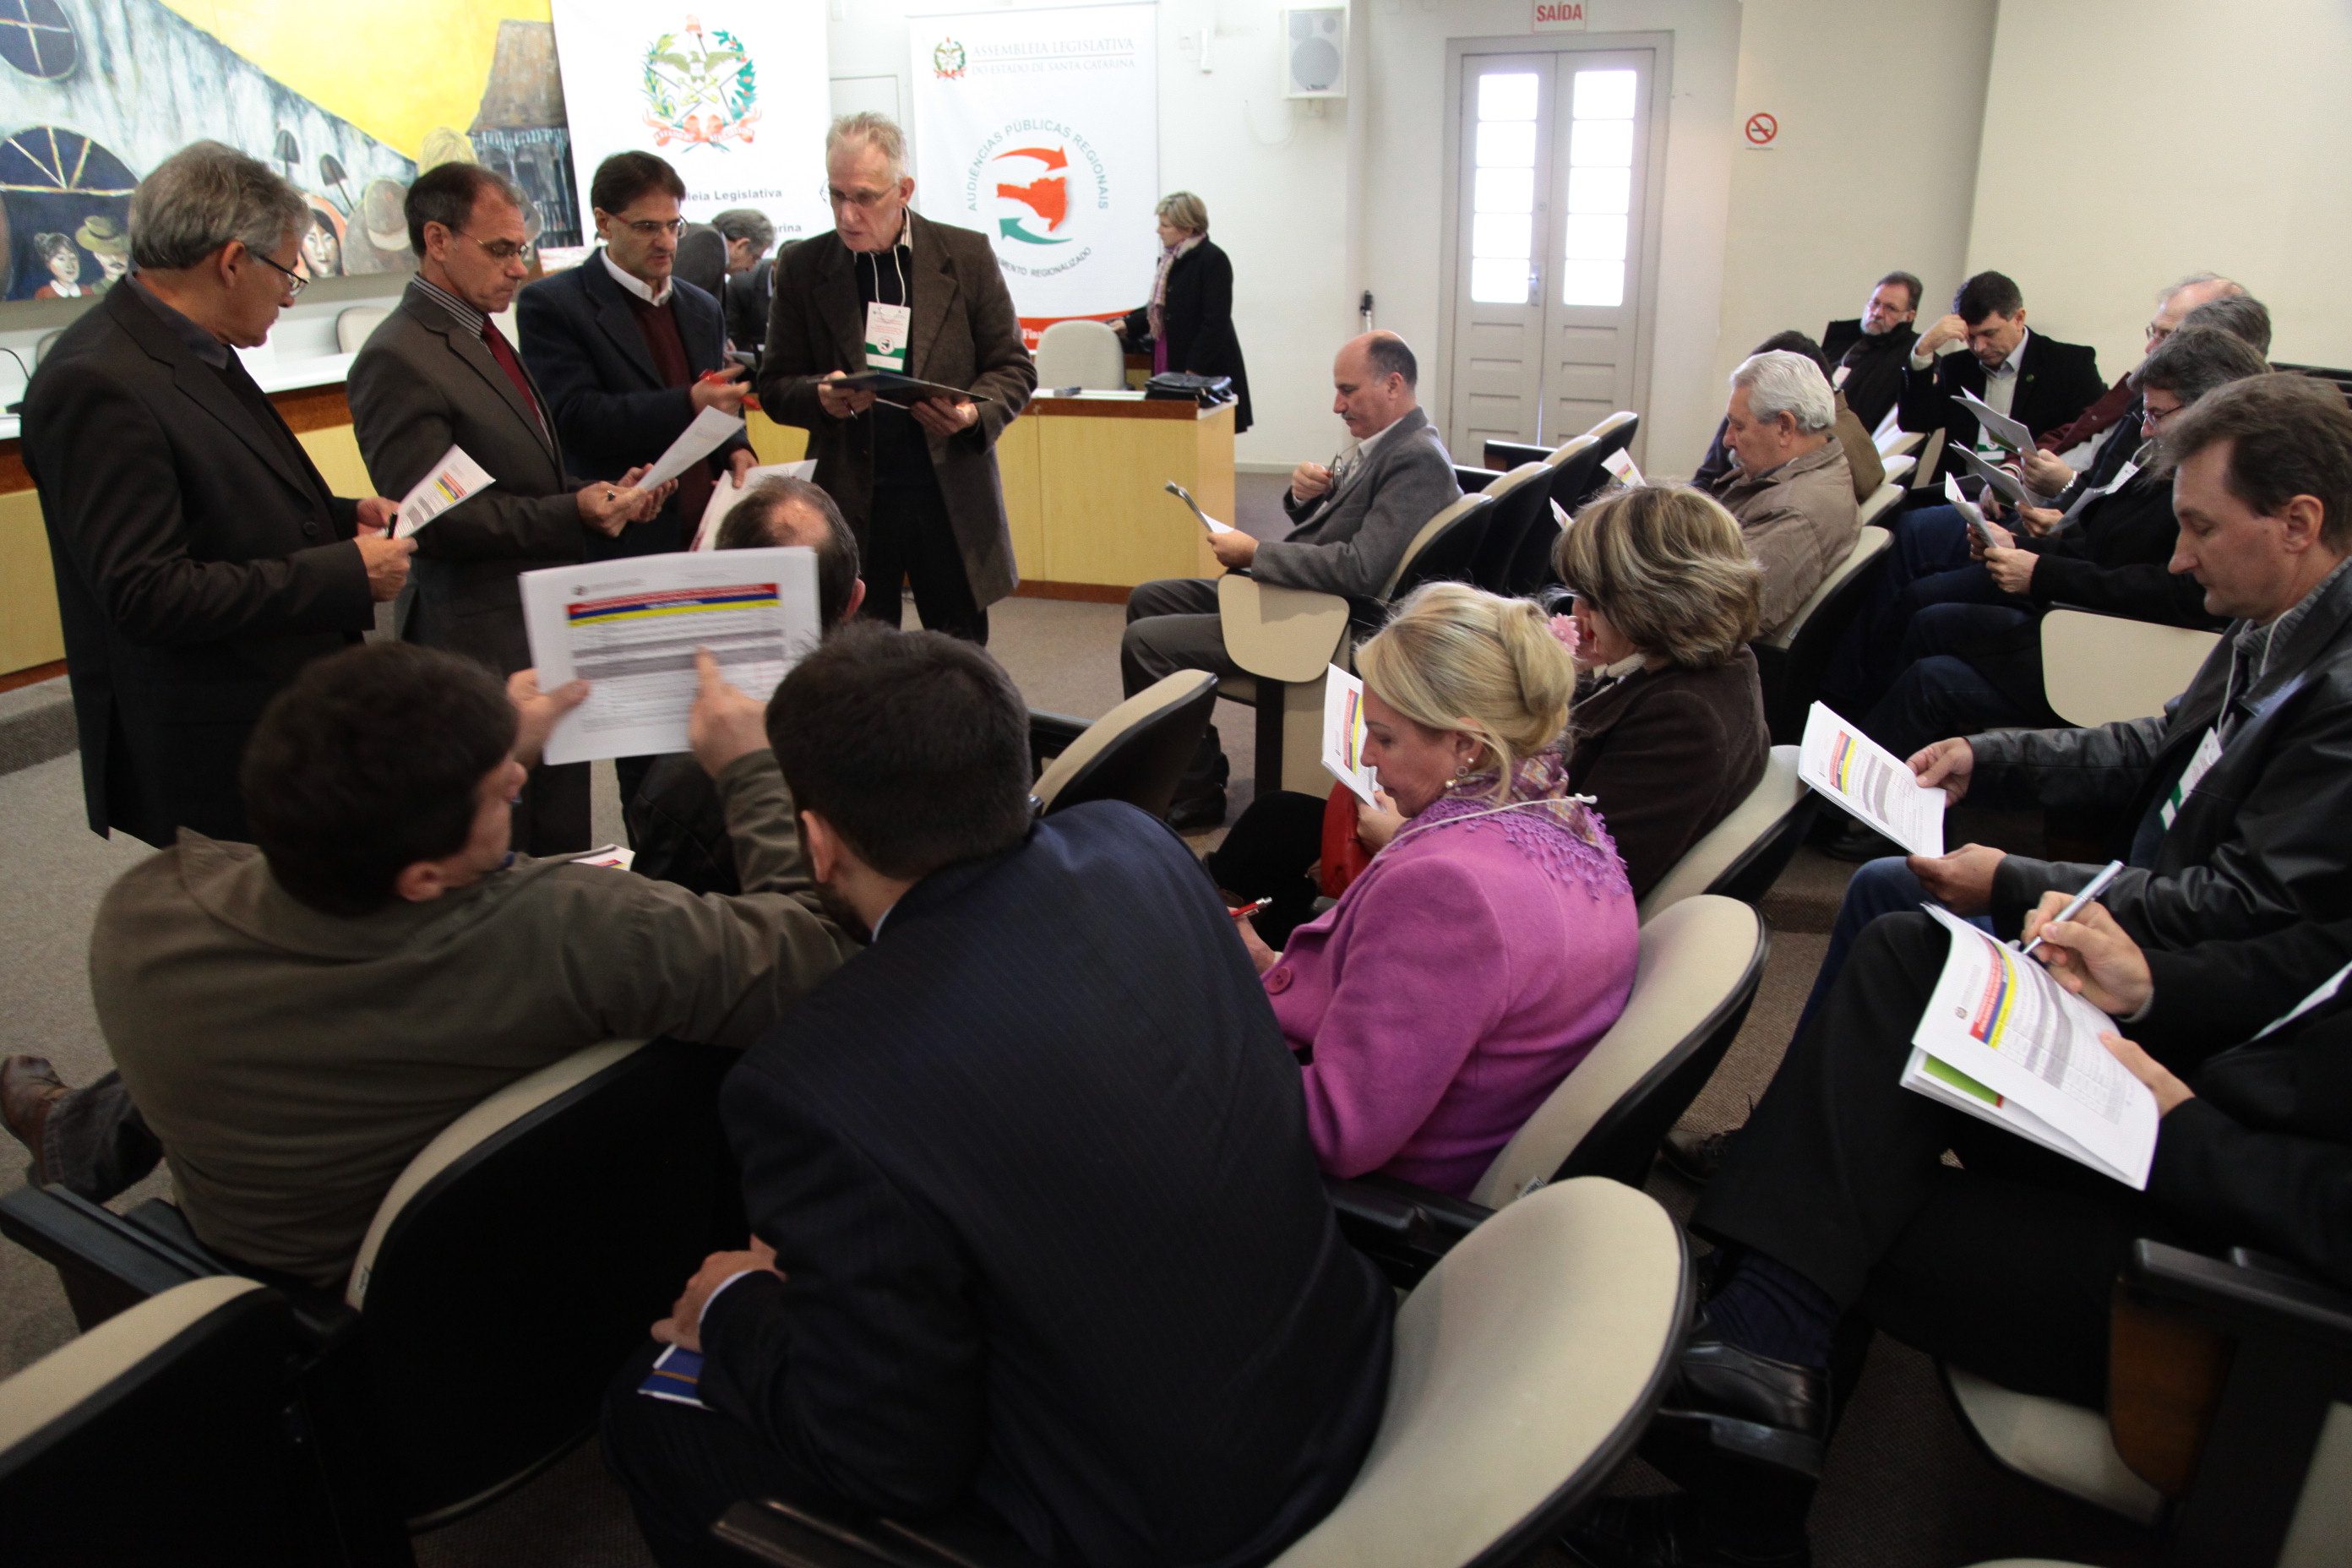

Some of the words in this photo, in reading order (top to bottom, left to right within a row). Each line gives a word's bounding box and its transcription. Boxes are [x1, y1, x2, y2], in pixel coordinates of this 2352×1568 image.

[1537, 1, 1582, 22] SAÍDA
[973, 42, 1048, 57] ASSEMBLEIA
[1053, 38, 1135, 53] LEGISLATIVA
[972, 65, 988, 75] DO
[990, 63, 1029, 74] ESTADO
[1032, 62, 1044, 73] DE
[1048, 61, 1081, 72] SANTA
[1083, 58, 1136, 69] CATARINA
[1072, 133, 1109, 210] REGIONAIS
[714, 188, 782, 202] Legislativa
[1031, 247, 1092, 278] REGIONALIZADO
